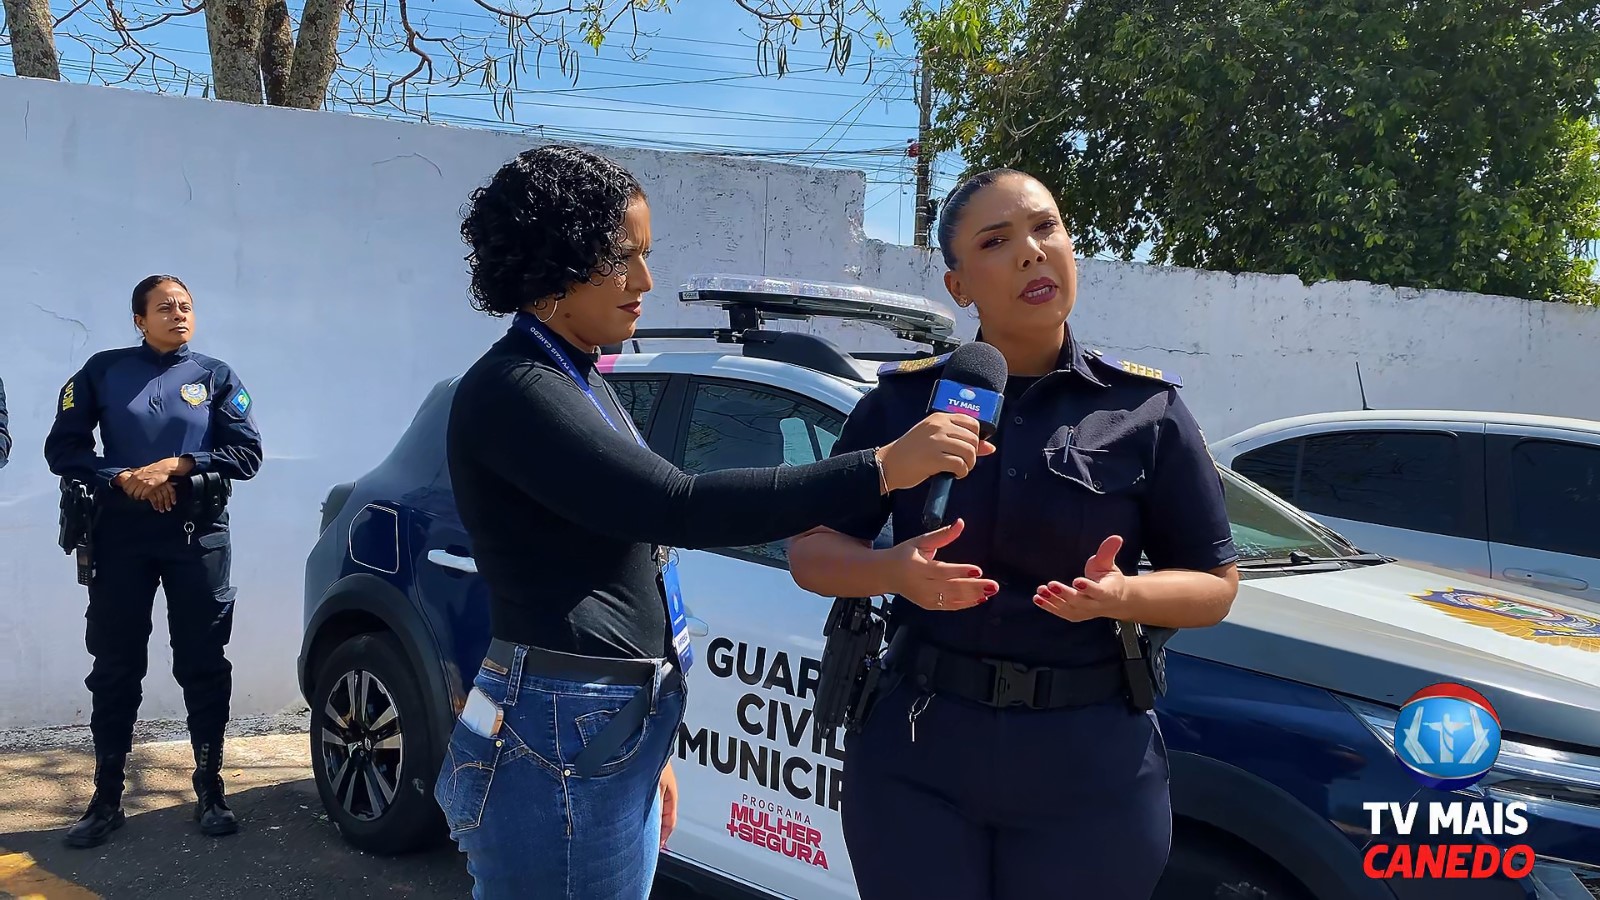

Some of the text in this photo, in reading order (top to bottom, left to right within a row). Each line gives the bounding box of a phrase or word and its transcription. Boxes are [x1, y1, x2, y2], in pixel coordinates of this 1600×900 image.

[62, 382, 75, 411] GCM
[948, 398, 961, 406] TV
[960, 401, 980, 412] MAIS
[742, 793, 811, 825] PROGRAMA
[731, 802, 822, 849] MULHER
